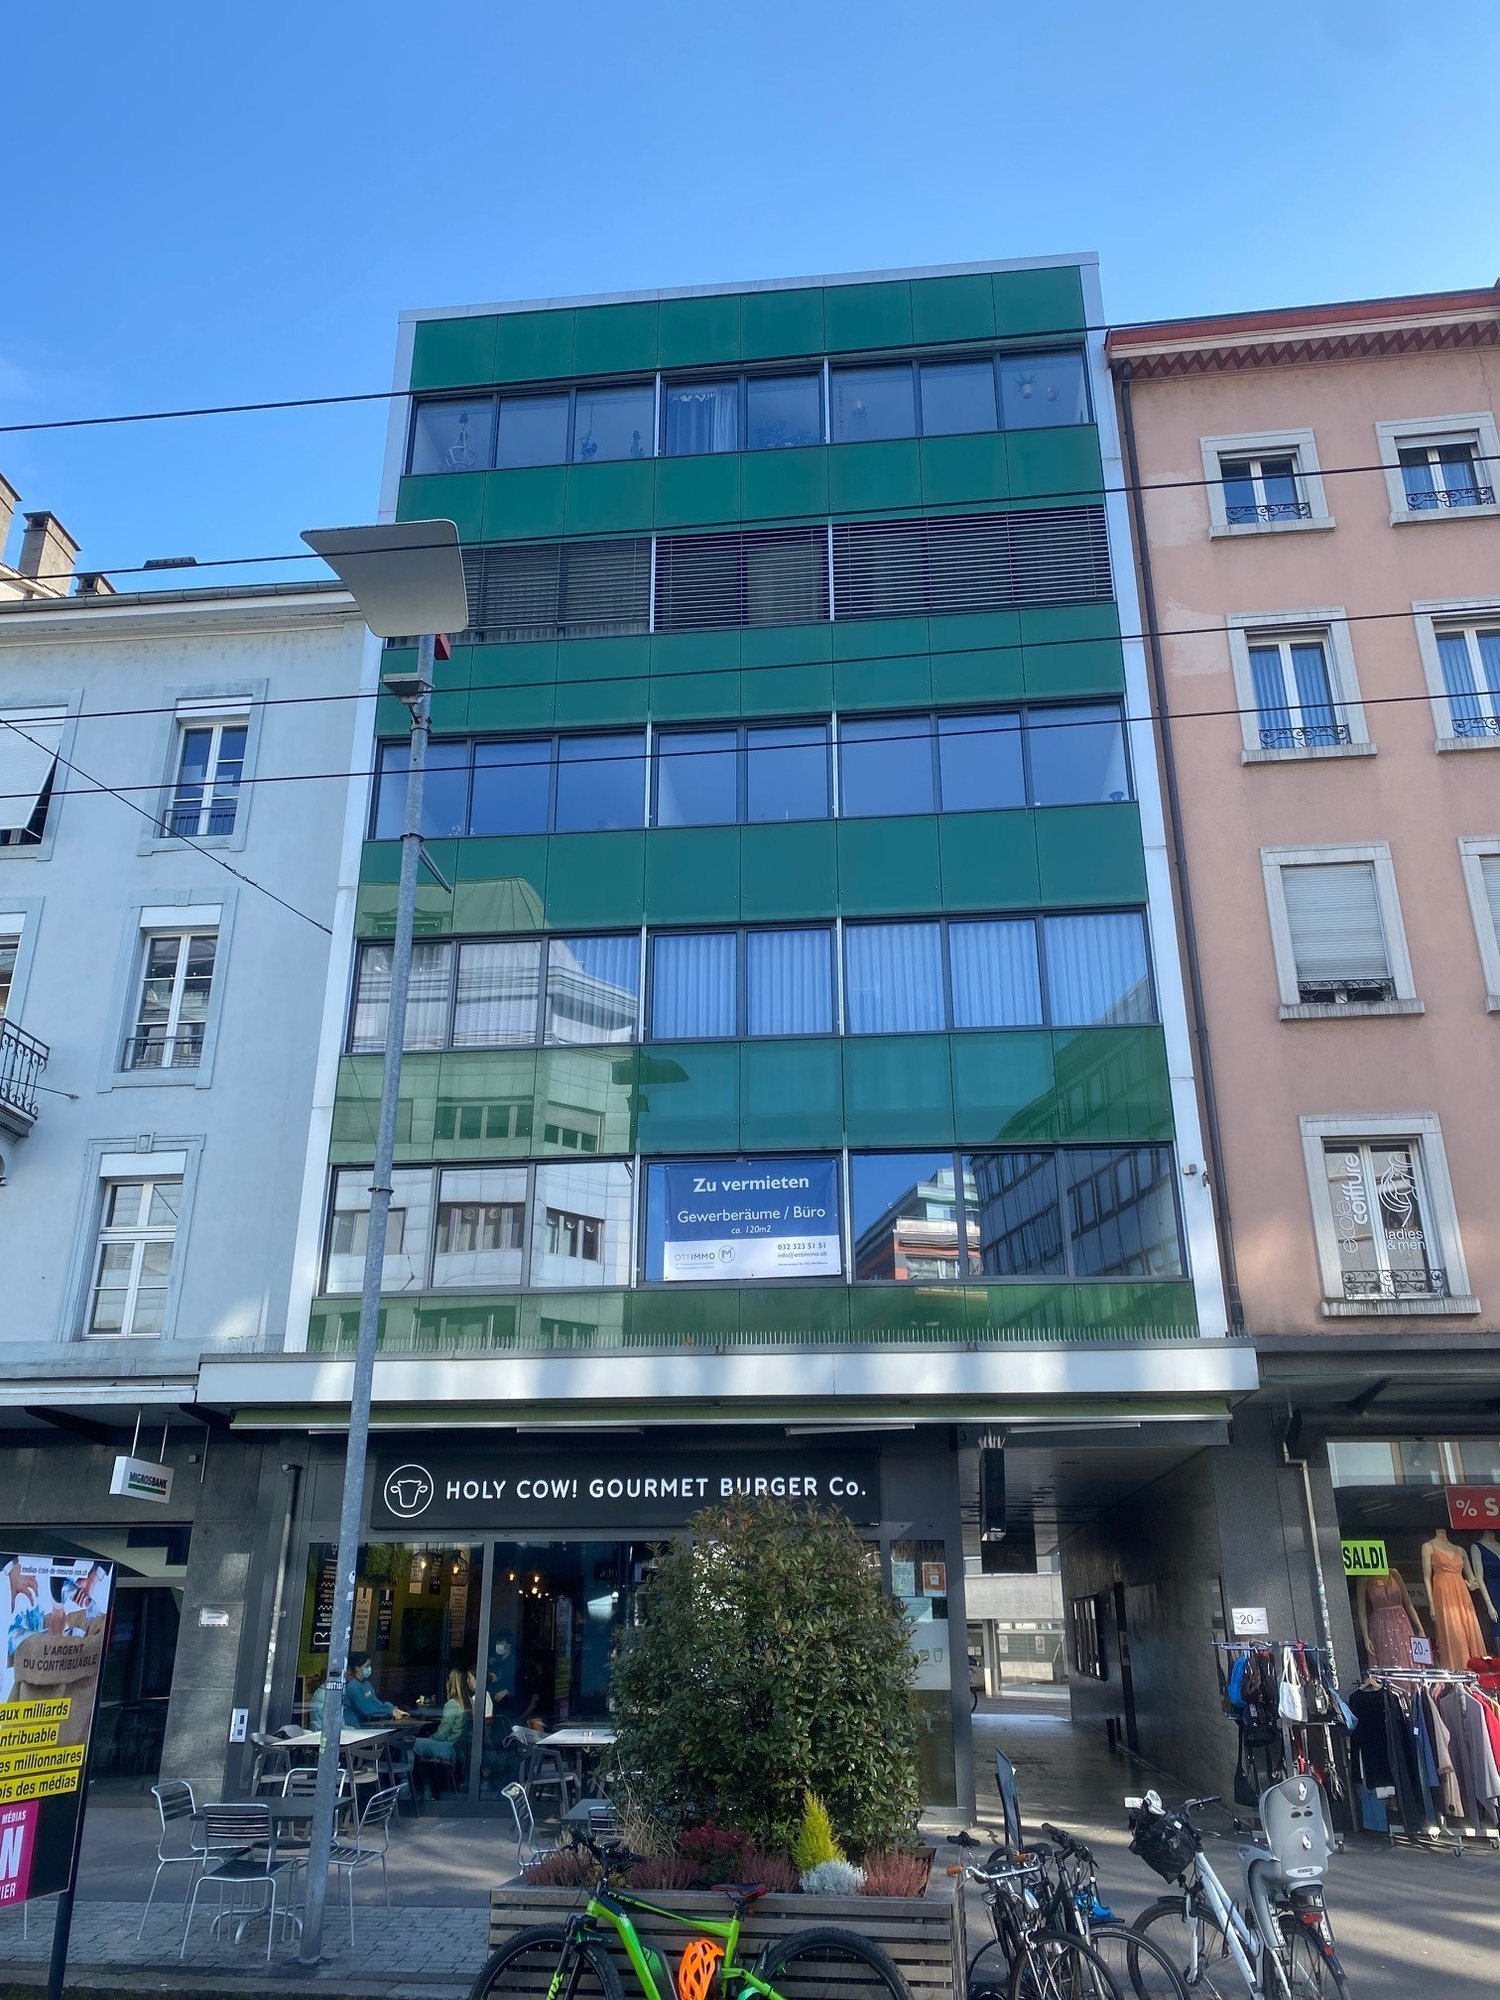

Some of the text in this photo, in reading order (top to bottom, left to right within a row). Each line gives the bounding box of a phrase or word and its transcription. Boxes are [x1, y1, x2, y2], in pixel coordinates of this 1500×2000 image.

[692, 1175, 810, 1193] Zu vermieten
[1341, 1152, 1368, 1225] coiffure
[677, 1205, 826, 1224] Gewerberäume / Büro
[731, 1224, 772, 1235] ca. 120m2
[1384, 1228, 1424, 1240] ladies
[777, 1241, 826, 1251] 032 323 51 51
[1386, 1240, 1426, 1251] & men
[674, 1252, 716, 1262] OTTIMMO
[128, 1471, 169, 1490] MIGROSBANK
[446, 1476, 867, 1500] HOLY COW! GOURMET BURGER Co.
[1455, 1497, 1500, 1517] % S
[1342, 1546, 1385, 1569] SALDI
[43, 1643, 85, 1656] L'ARGENT
[23, 1654, 99, 1672] DU CONTRIBUABLE
[22, 1702, 69, 1720] milliards
[0, 1727, 57, 1748] ntribuable
[0, 1750, 82, 1774] es millionnaires
[16, 1781, 36, 1797] des
[38, 1775, 77, 1793] médias
[2, 1810, 27, 1825] MÉDIAS
[0, 1882, 16, 1900] IER
